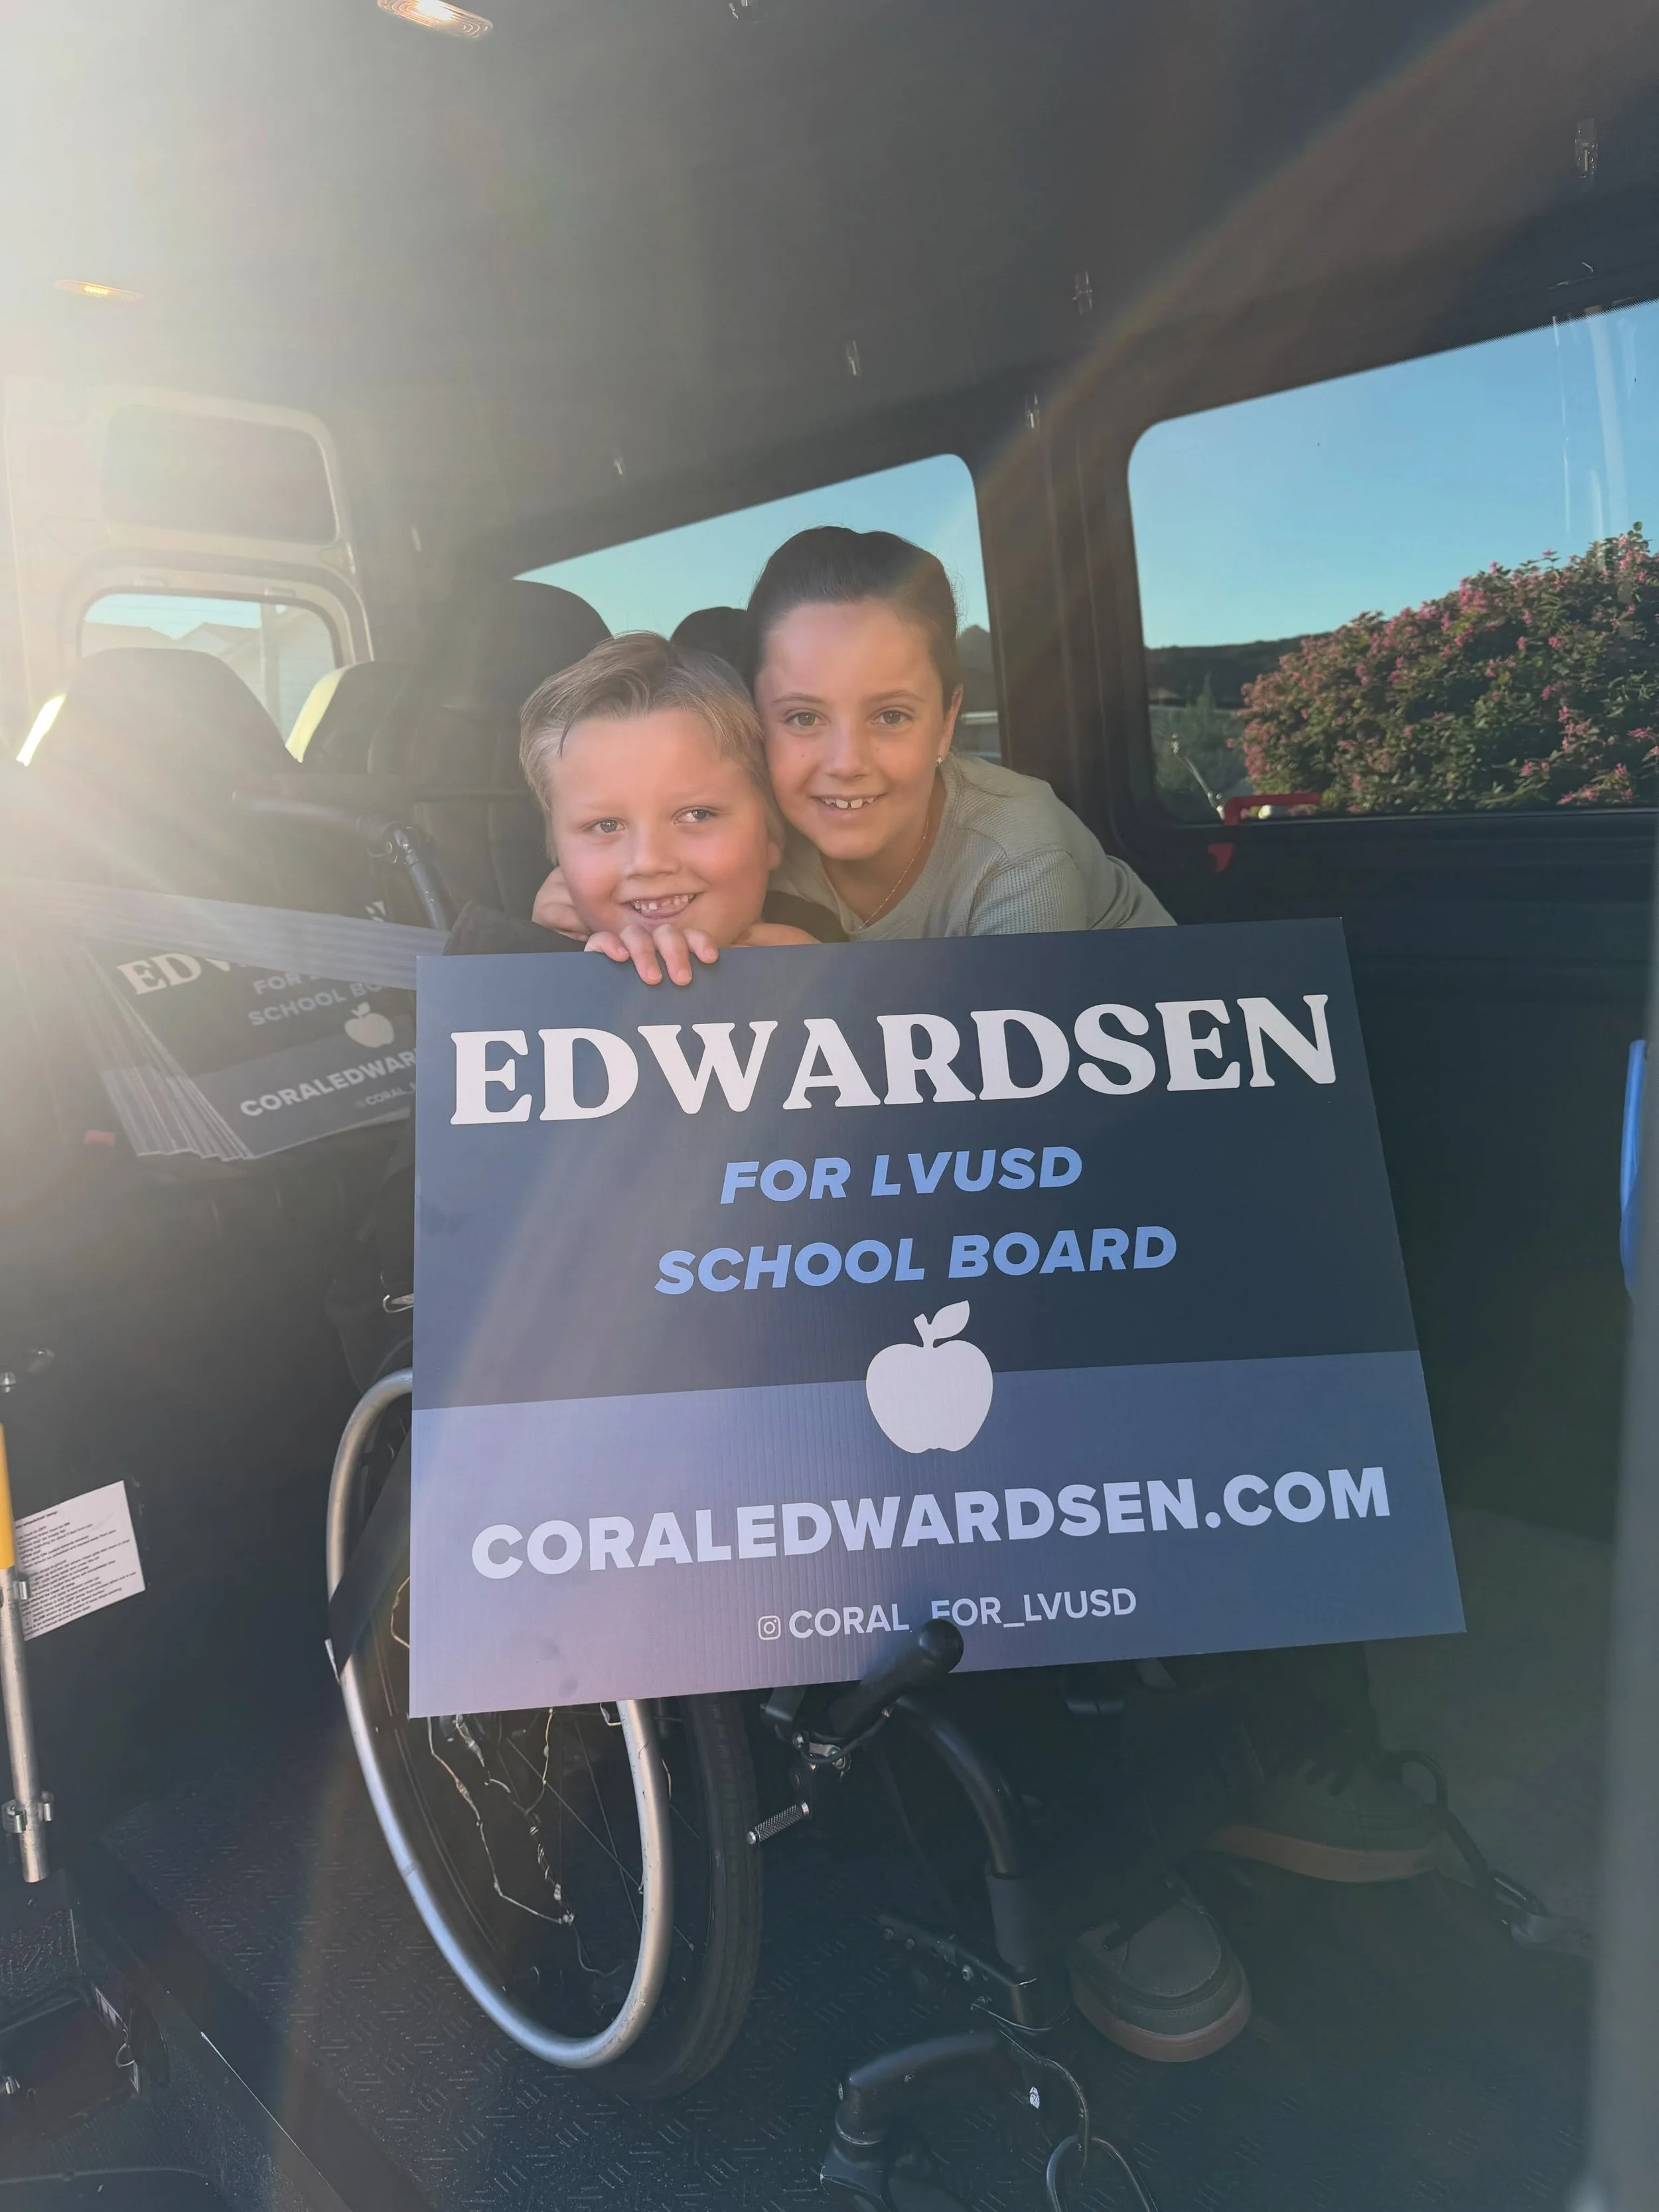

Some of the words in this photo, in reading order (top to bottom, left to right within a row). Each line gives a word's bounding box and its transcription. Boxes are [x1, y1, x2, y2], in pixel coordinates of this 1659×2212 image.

[248, 990, 346, 1026] SCHOOL
[240, 1049, 417, 1117] CORALEDWAR
[451, 994, 1336, 1125] EDWARDSEN
[720, 1157, 851, 1205] FOR
[871, 1146, 1082, 1196] LVUSD
[654, 1238, 924, 1295] SCHOOL
[948, 1226, 1177, 1279] BOARD
[472, 1467, 1390, 1579] CORALEDWARDSEN.COM
[788, 1587, 1137, 1639] CORALFOR_LVUSD
